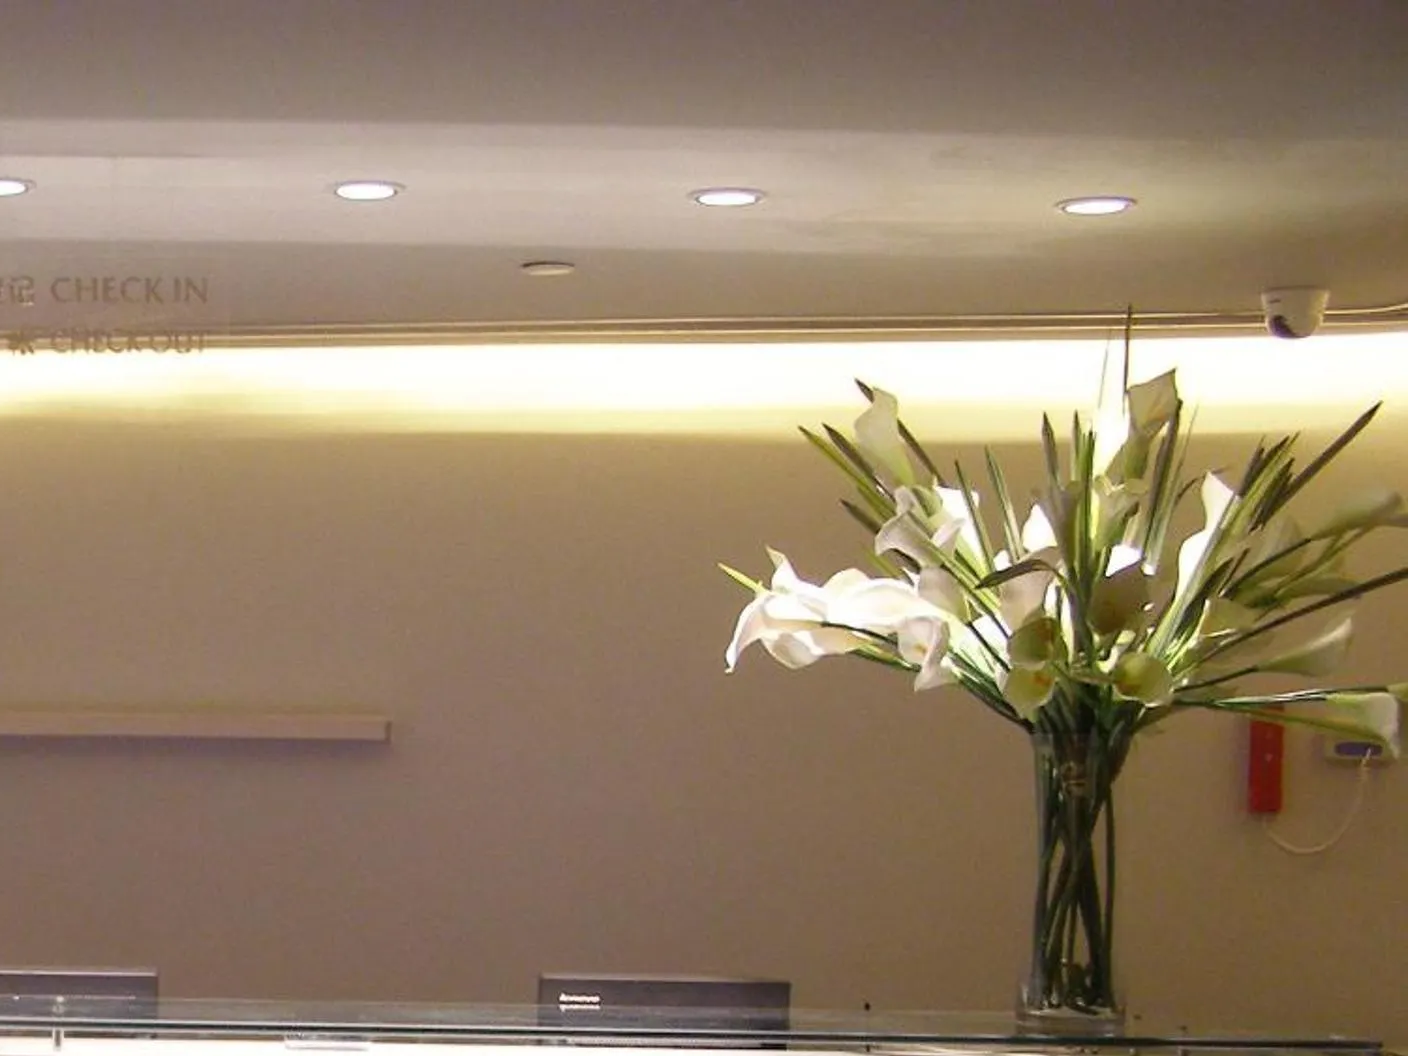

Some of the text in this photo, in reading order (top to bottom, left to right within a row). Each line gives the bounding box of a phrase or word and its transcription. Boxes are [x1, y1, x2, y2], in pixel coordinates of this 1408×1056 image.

[50, 275, 209, 304] CHECK IN
[50, 327, 209, 354] CHECK OUT
